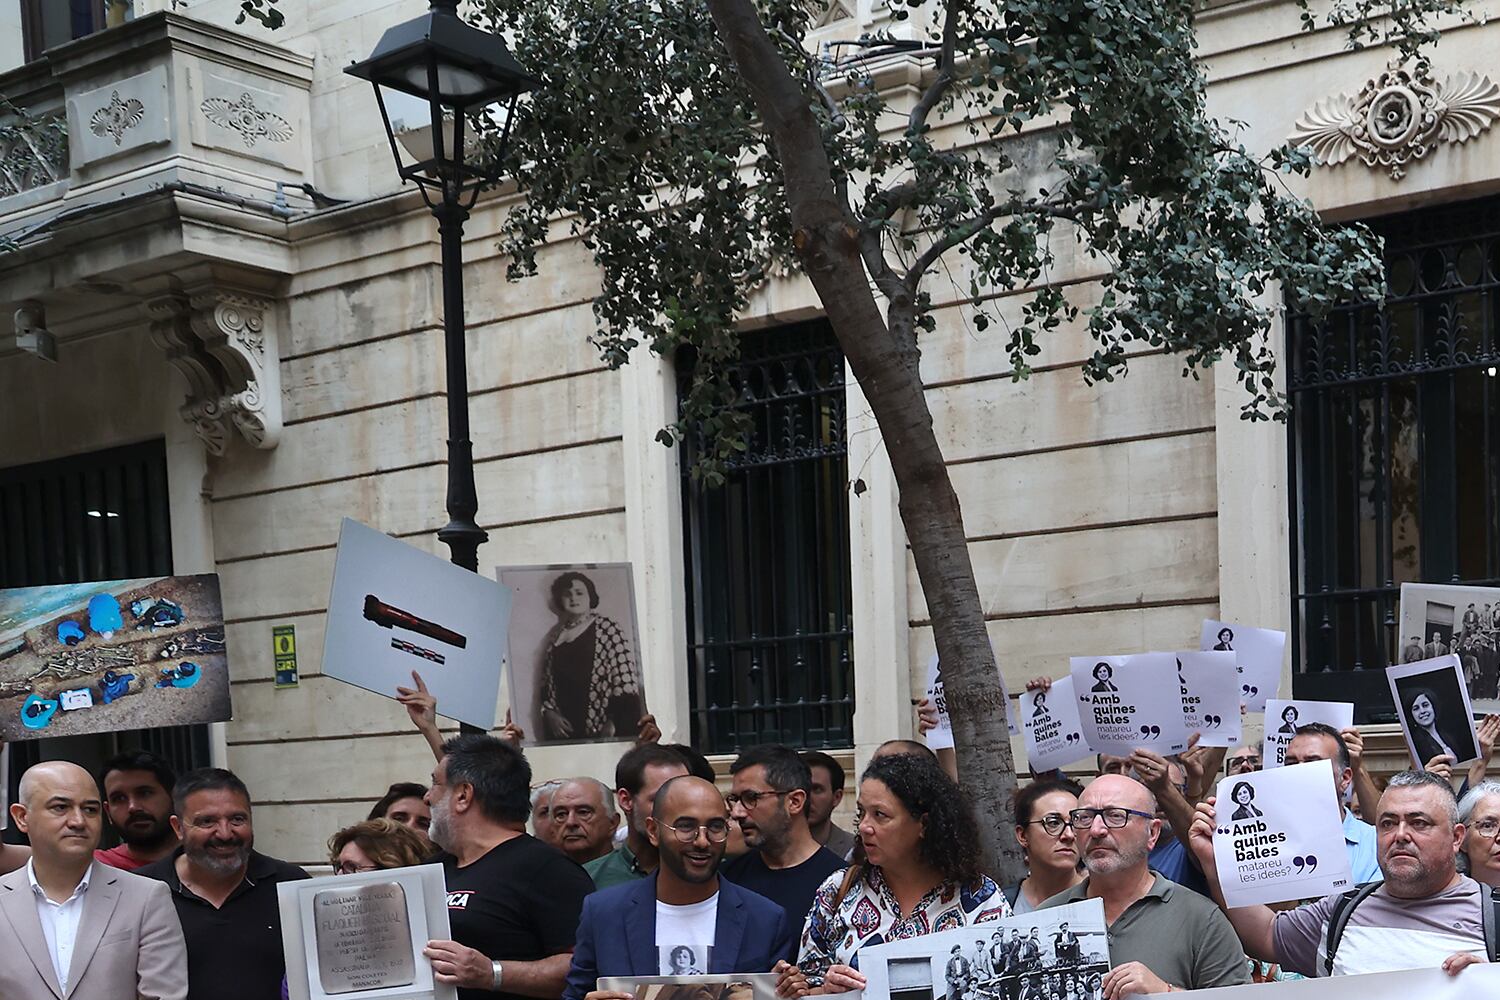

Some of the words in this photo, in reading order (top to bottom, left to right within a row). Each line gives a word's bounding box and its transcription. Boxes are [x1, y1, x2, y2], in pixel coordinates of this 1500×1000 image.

[1093, 704, 1136, 717] quines
[1094, 715, 1130, 724] bales
[1034, 720, 1062, 736] quines
[1097, 725, 1132, 733] matareu
[1035, 730, 1059, 743] bales
[1234, 832, 1286, 852] quines
[1235, 846, 1279, 862] bales
[1238, 859, 1282, 873] matareu
[1239, 873, 1256, 883] les
[1257, 865, 1292, 880] idees?
